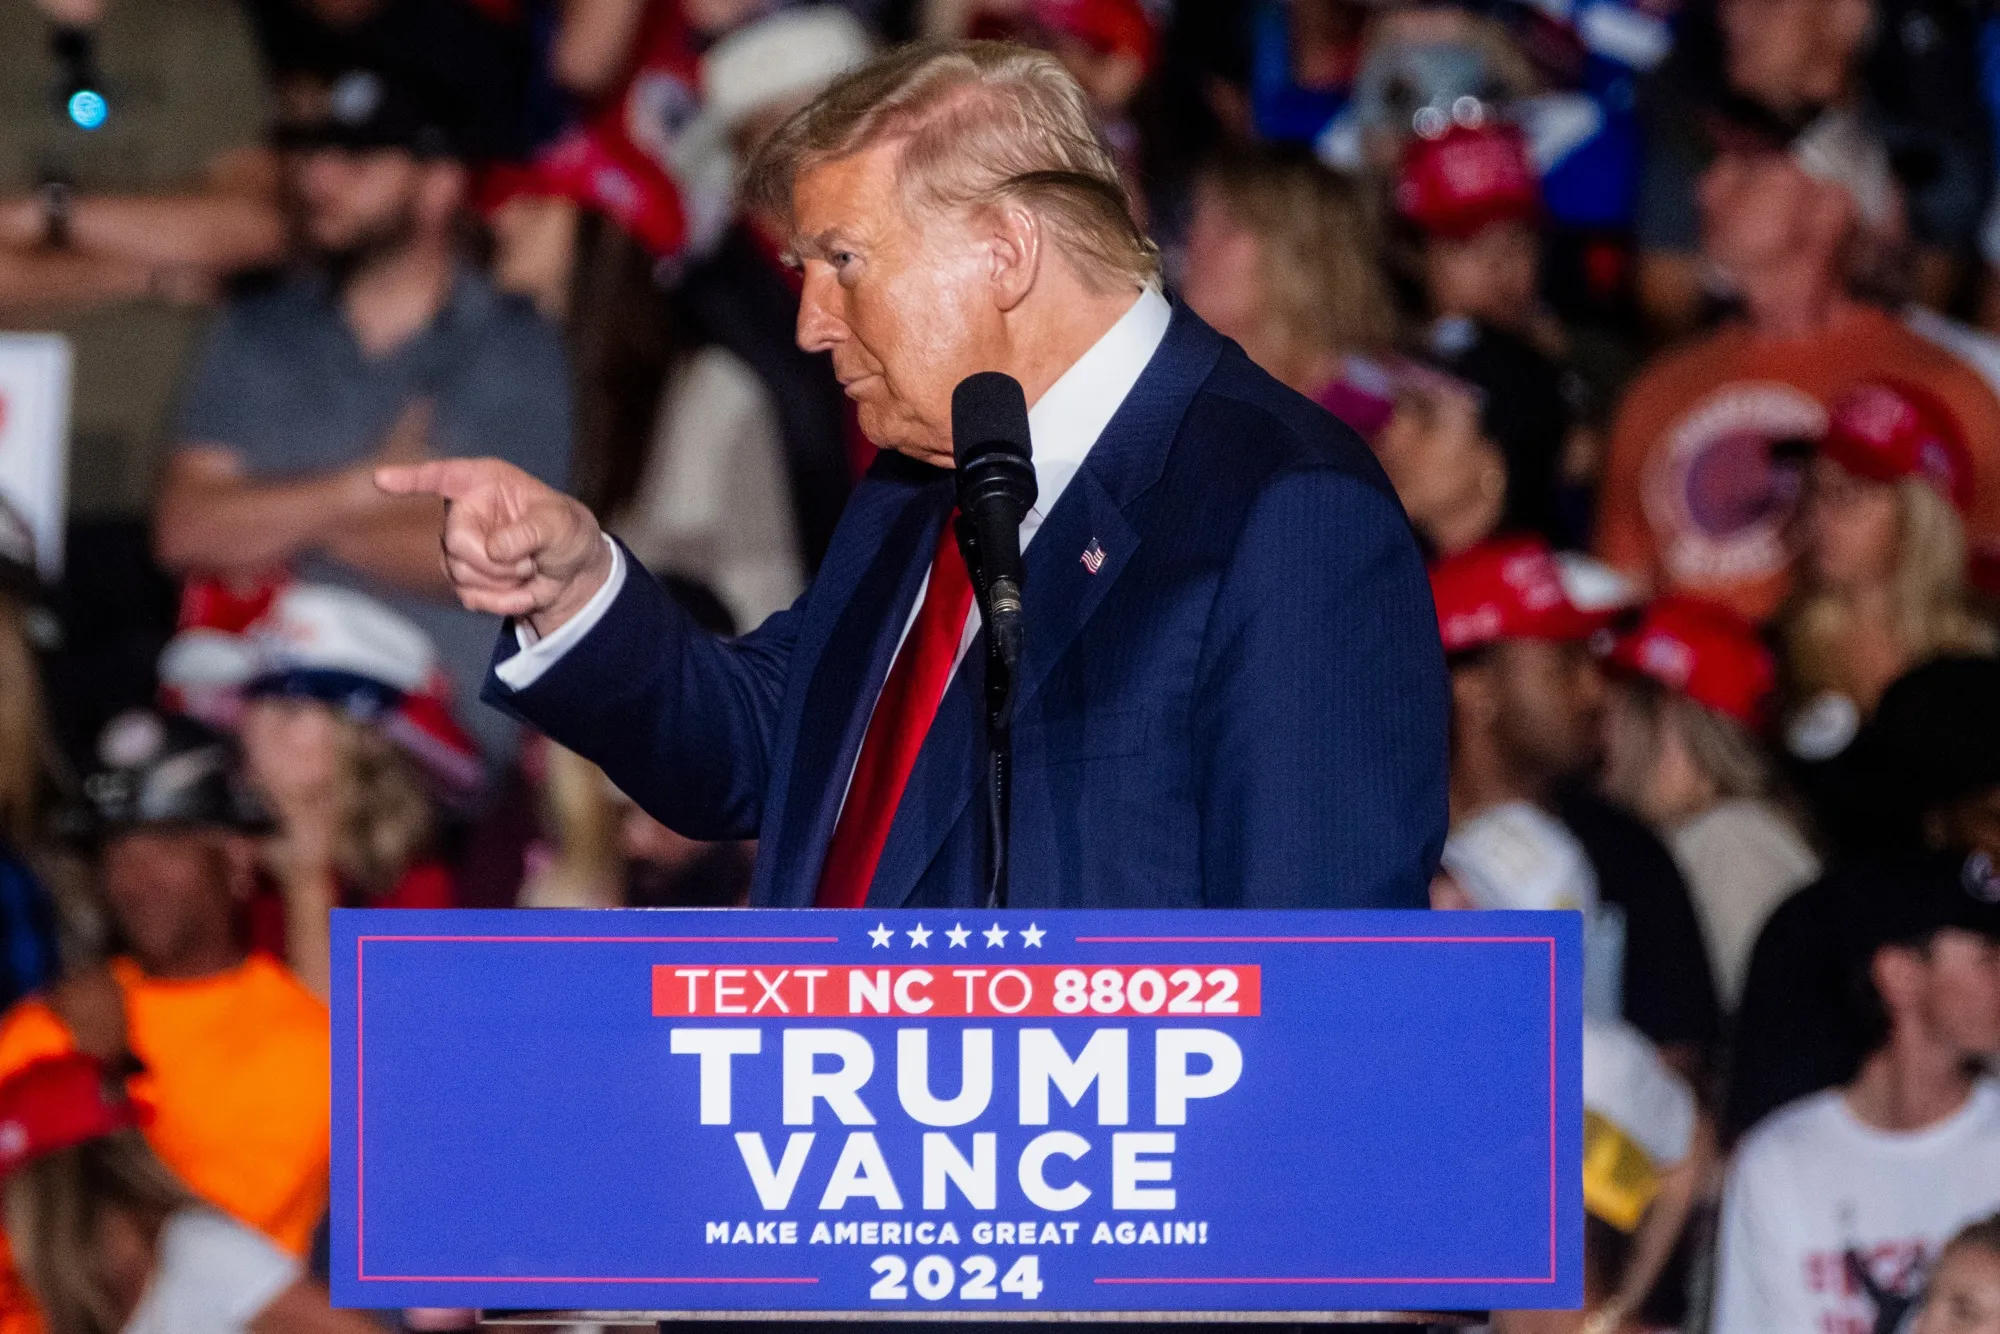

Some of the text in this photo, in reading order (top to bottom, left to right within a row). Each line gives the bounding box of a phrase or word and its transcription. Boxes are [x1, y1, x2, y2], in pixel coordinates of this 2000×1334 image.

[675, 968, 1240, 1014] TEXT NC TO 88022
[670, 1028, 1243, 1127] TRUMP
[734, 1131, 1177, 1212] VANCE
[705, 1221, 1208, 1245] MAKE AMERICA GREAT AGAIN!
[869, 1254, 1044, 1301] 2024
